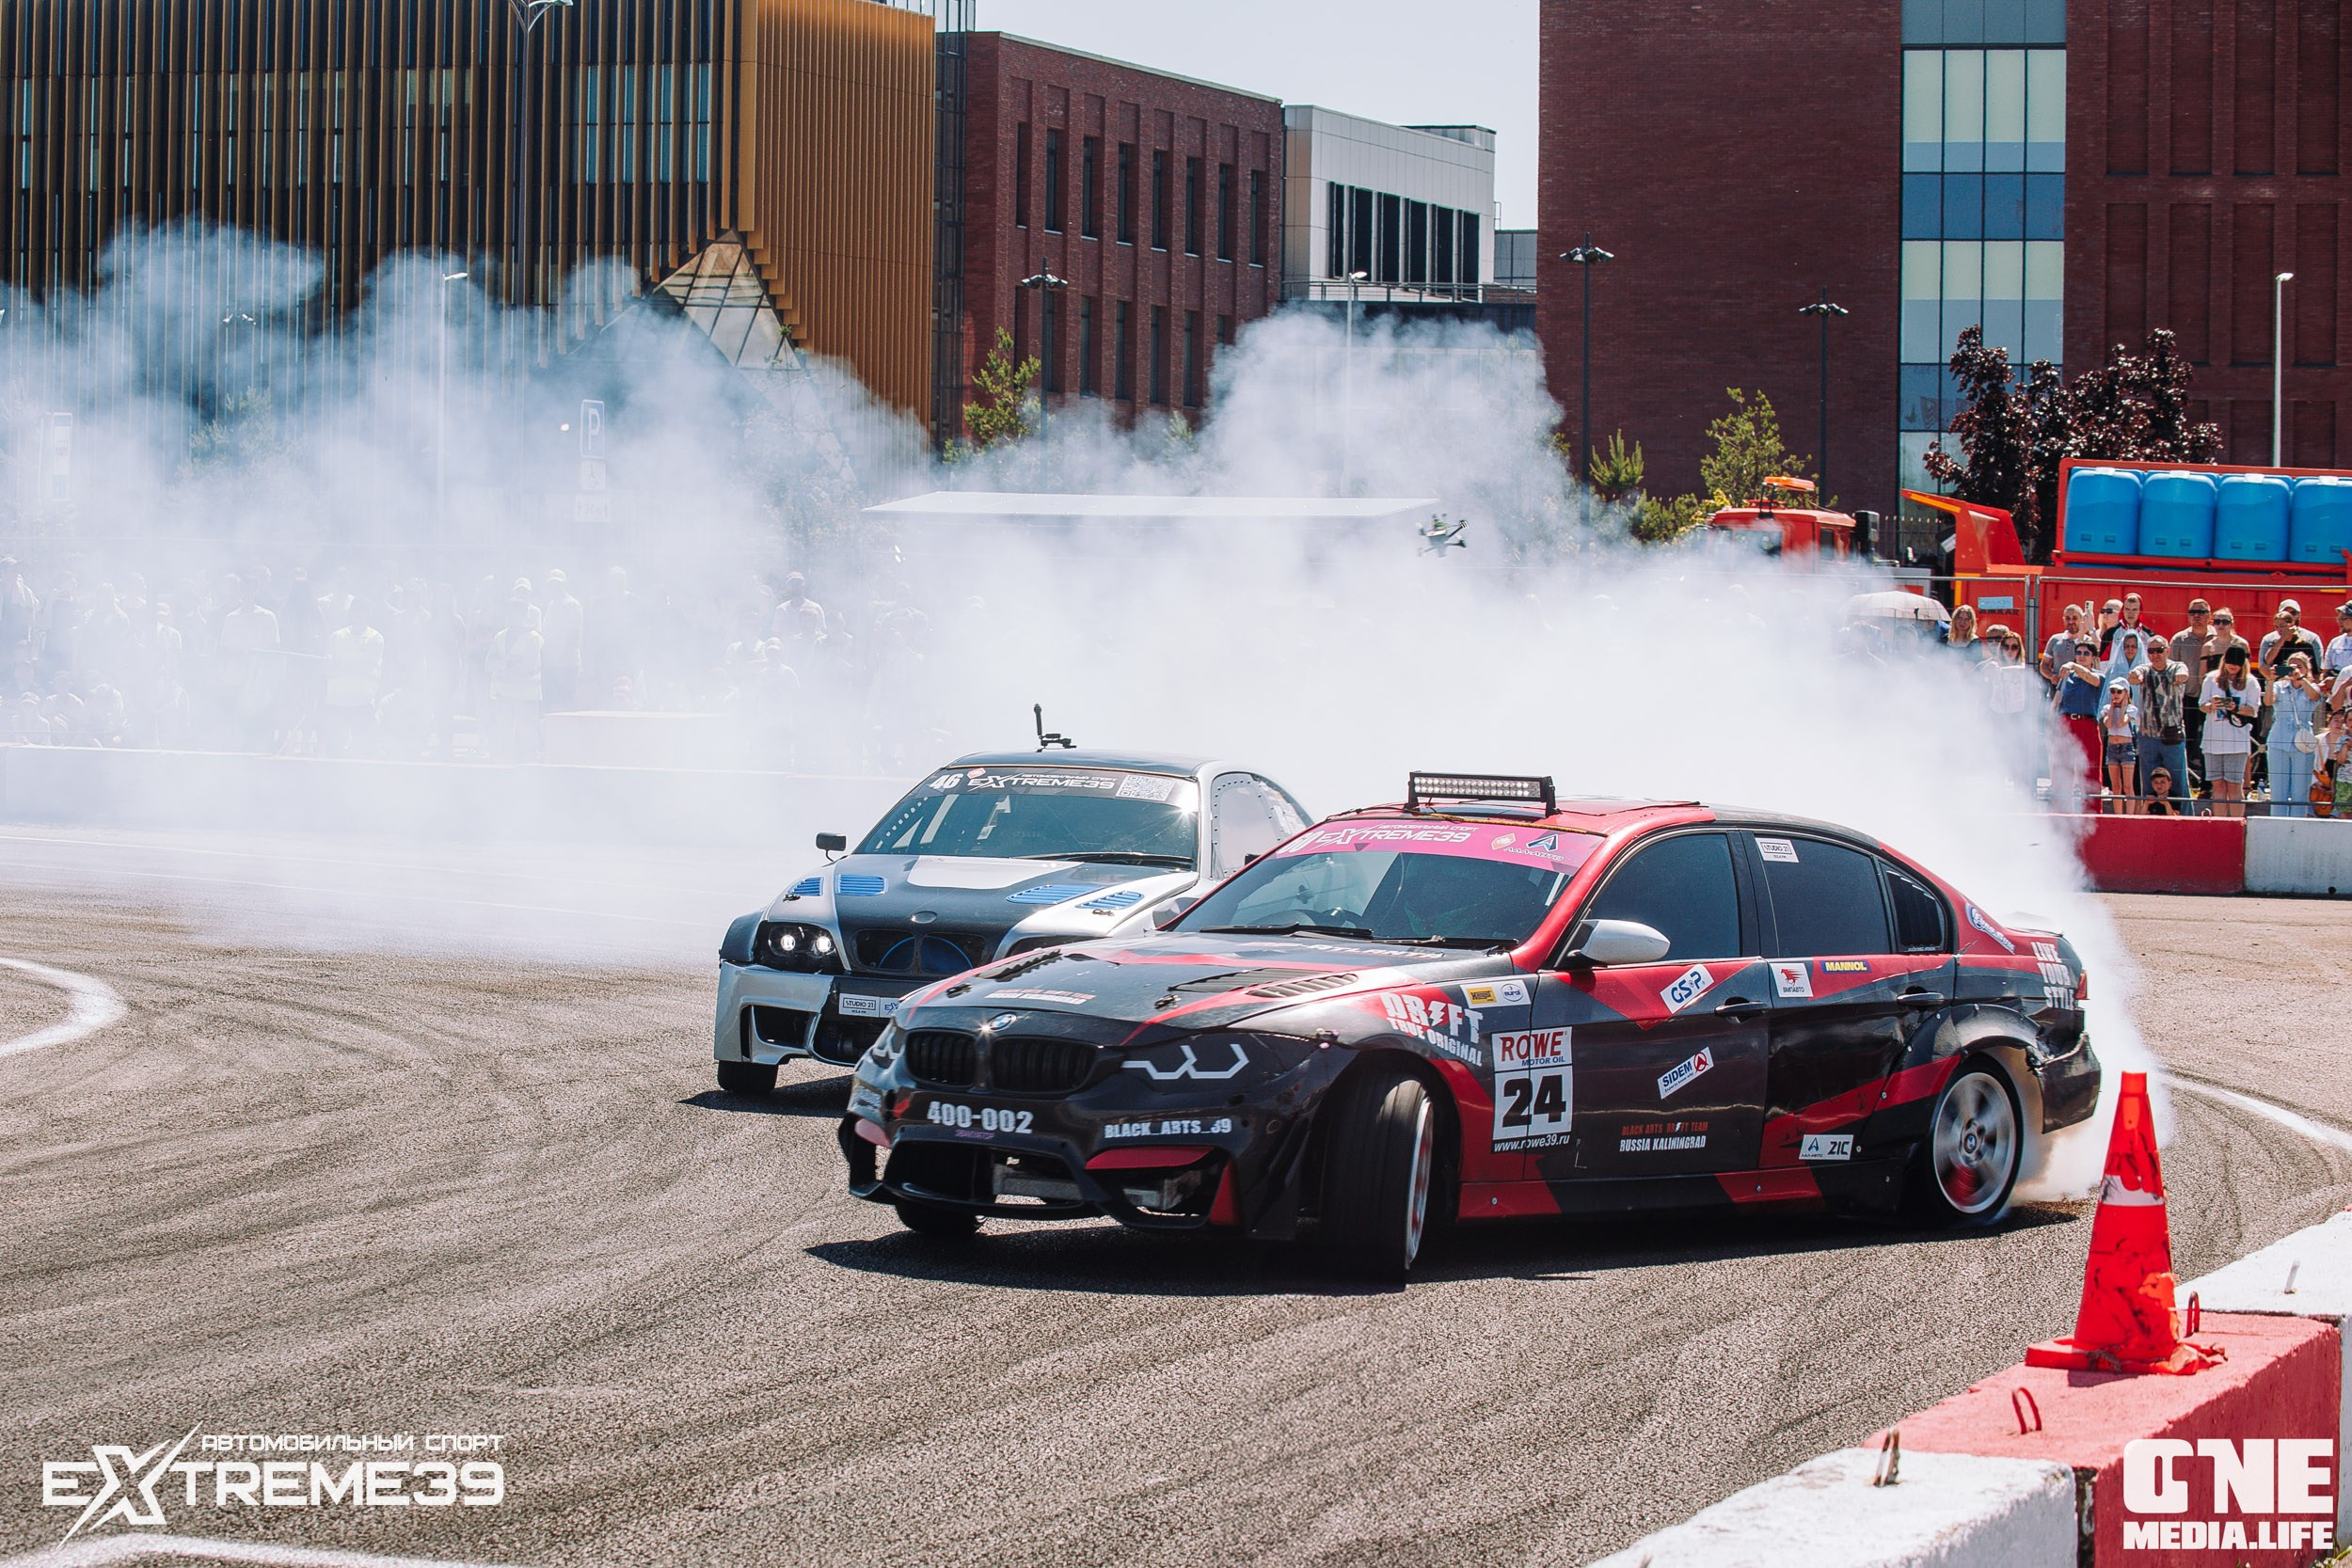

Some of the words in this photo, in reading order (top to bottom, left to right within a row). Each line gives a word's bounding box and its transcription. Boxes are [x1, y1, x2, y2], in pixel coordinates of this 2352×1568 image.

[588, 407, 600, 451] P
[930, 773, 963, 789] 46
[968, 773, 1115, 791] EXTREME39
[1309, 822, 1471, 851] EXTREME39
[2031, 942, 2062, 963] LIVE
[1825, 961, 1867, 972] MANNOL
[2037, 962, 2071, 986] YOUR
[2043, 986, 2075, 1011] STYLE
[1387, 1017, 1425, 1038] TRUE
[1427, 1029, 1483, 1067] ORIGINAL
[1499, 1031, 1565, 1062] ROWE
[1521, 1057, 1550, 1067] MOTOR
[1662, 1061, 1692, 1087] SIDEM
[1502, 1074, 1566, 1128] 24
[927, 1101, 1034, 1134] 400-002
[1621, 1125, 1644, 1136] BLACK
[1645, 1124, 1663, 1134] ARTS
[1691, 1121, 1708, 1132] TEAM
[1494, 1133, 1570, 1152] www.rowe39.ru
[1619, 1138, 1651, 1152] RUSSIA
[1652, 1135, 1707, 1150] KALININGRAD
[1827, 1141, 1851, 1156] ZIC
